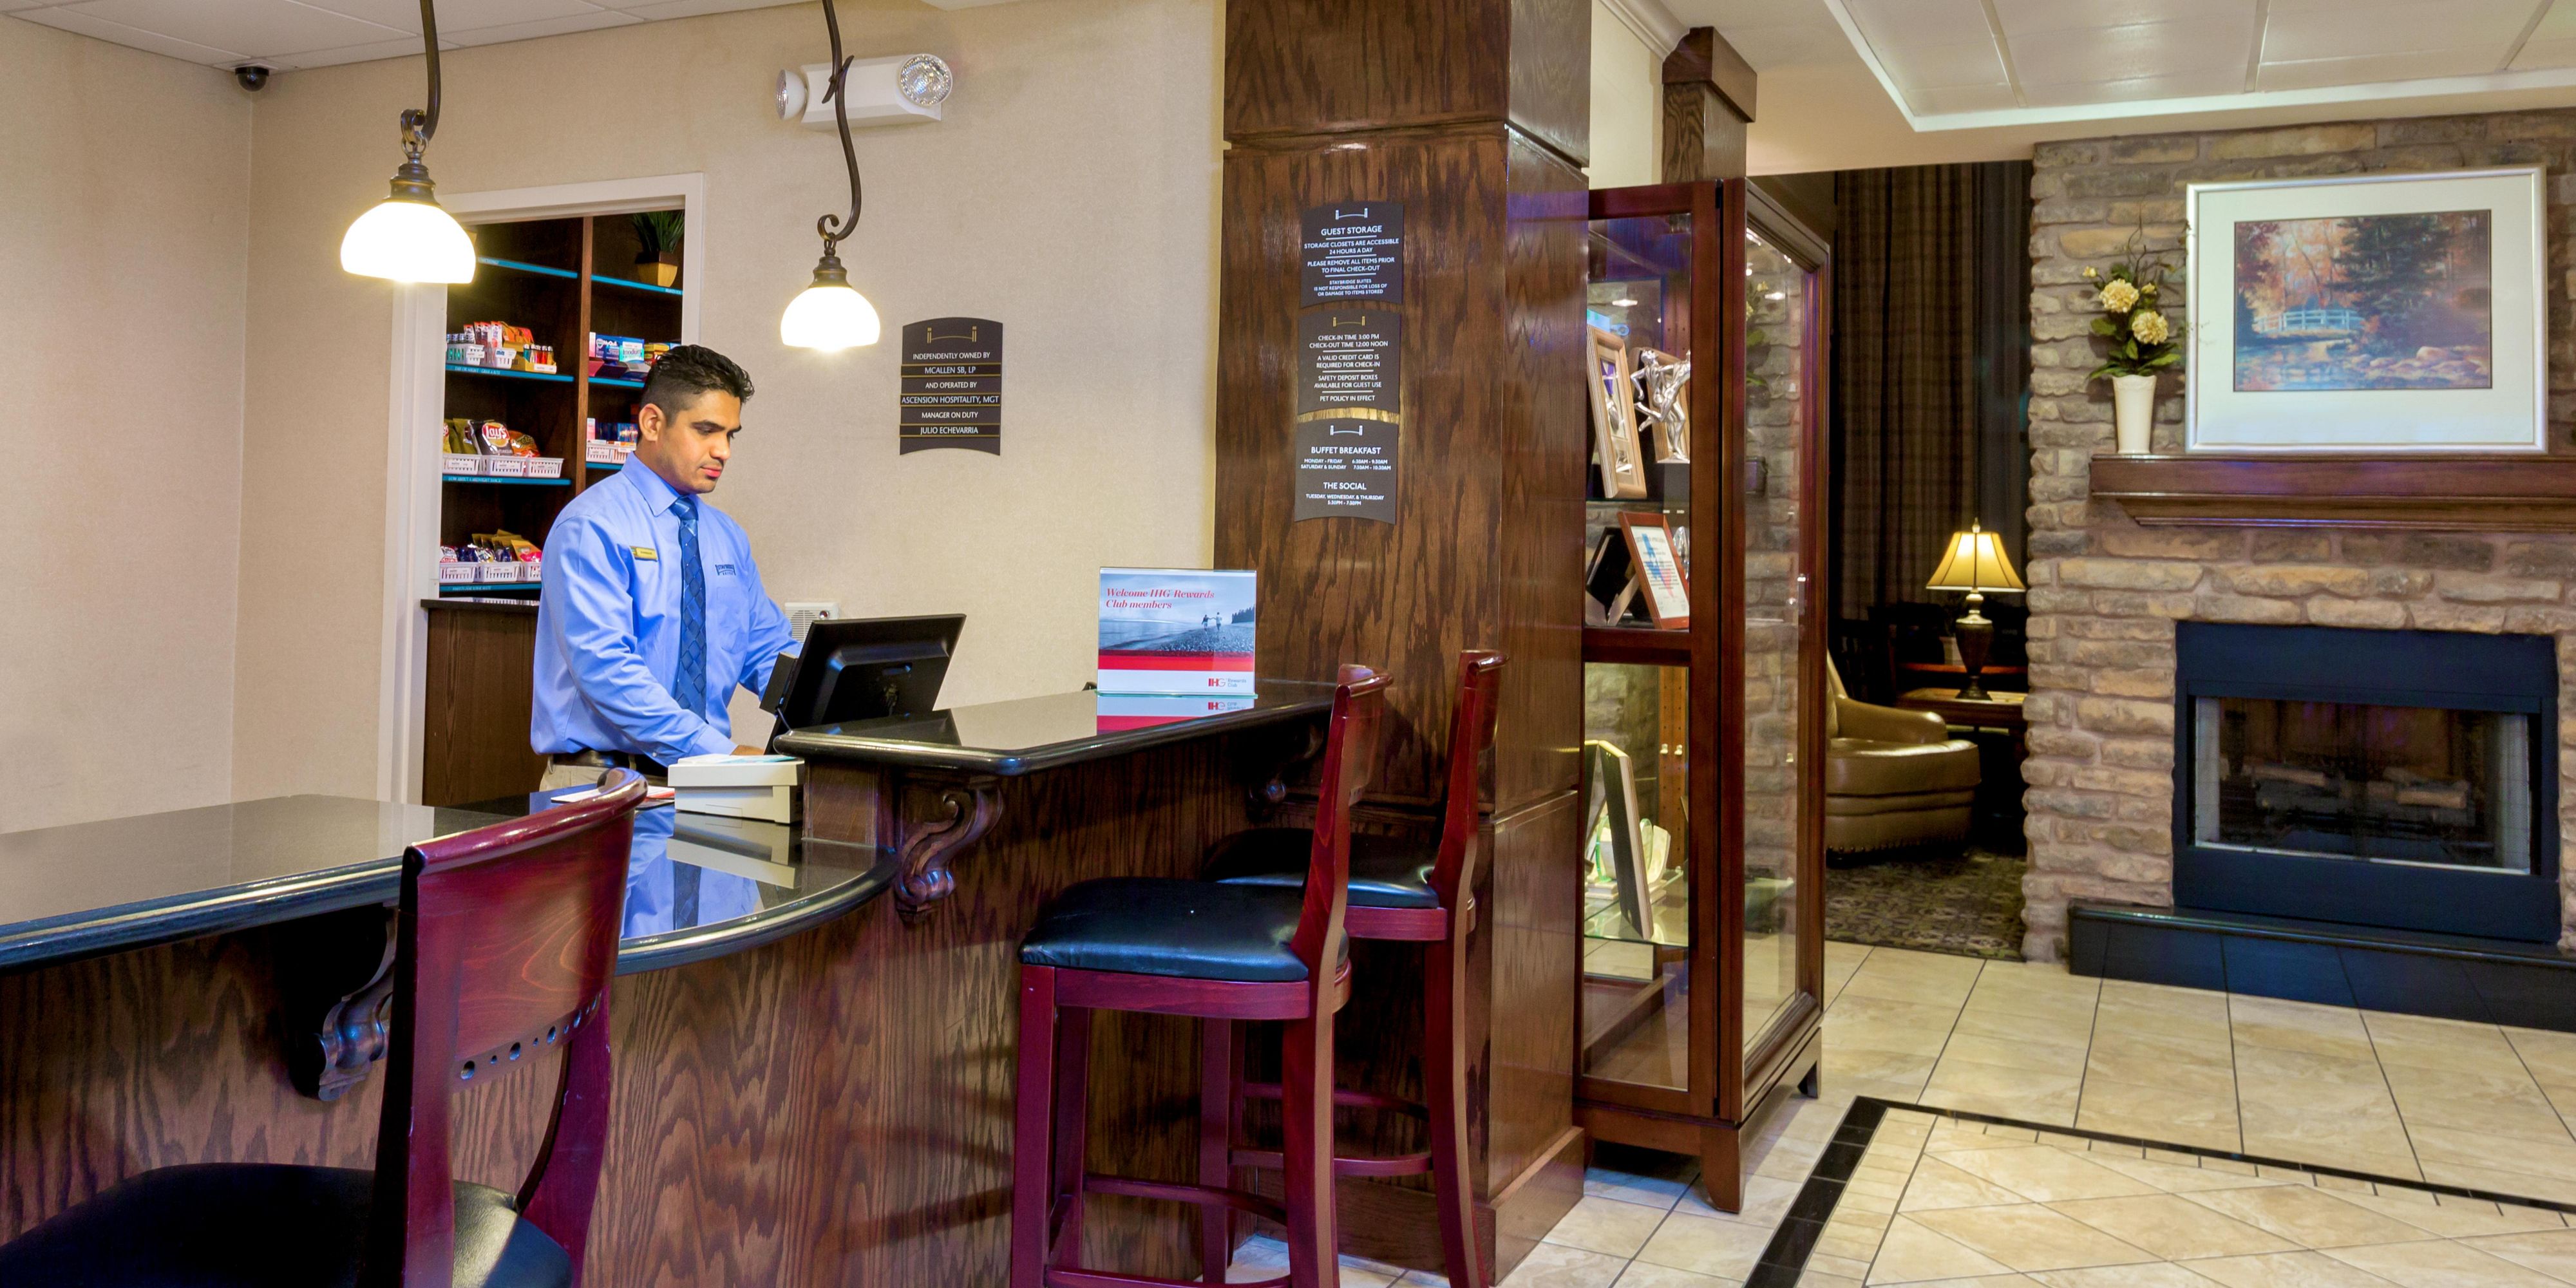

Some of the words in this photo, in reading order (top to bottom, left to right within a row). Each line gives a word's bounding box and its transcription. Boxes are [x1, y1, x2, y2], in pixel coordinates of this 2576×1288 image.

[1321, 227, 1346, 236] GUEST
[1347, 225, 1382, 234] STORAGE
[486, 425, 507, 439] Lay's
[1106, 588, 1148, 598] Welcome
[1174, 590, 1215, 598] Rewards
[1106, 600, 1128, 609] Club
[1208, 678, 1226, 687] IHG
